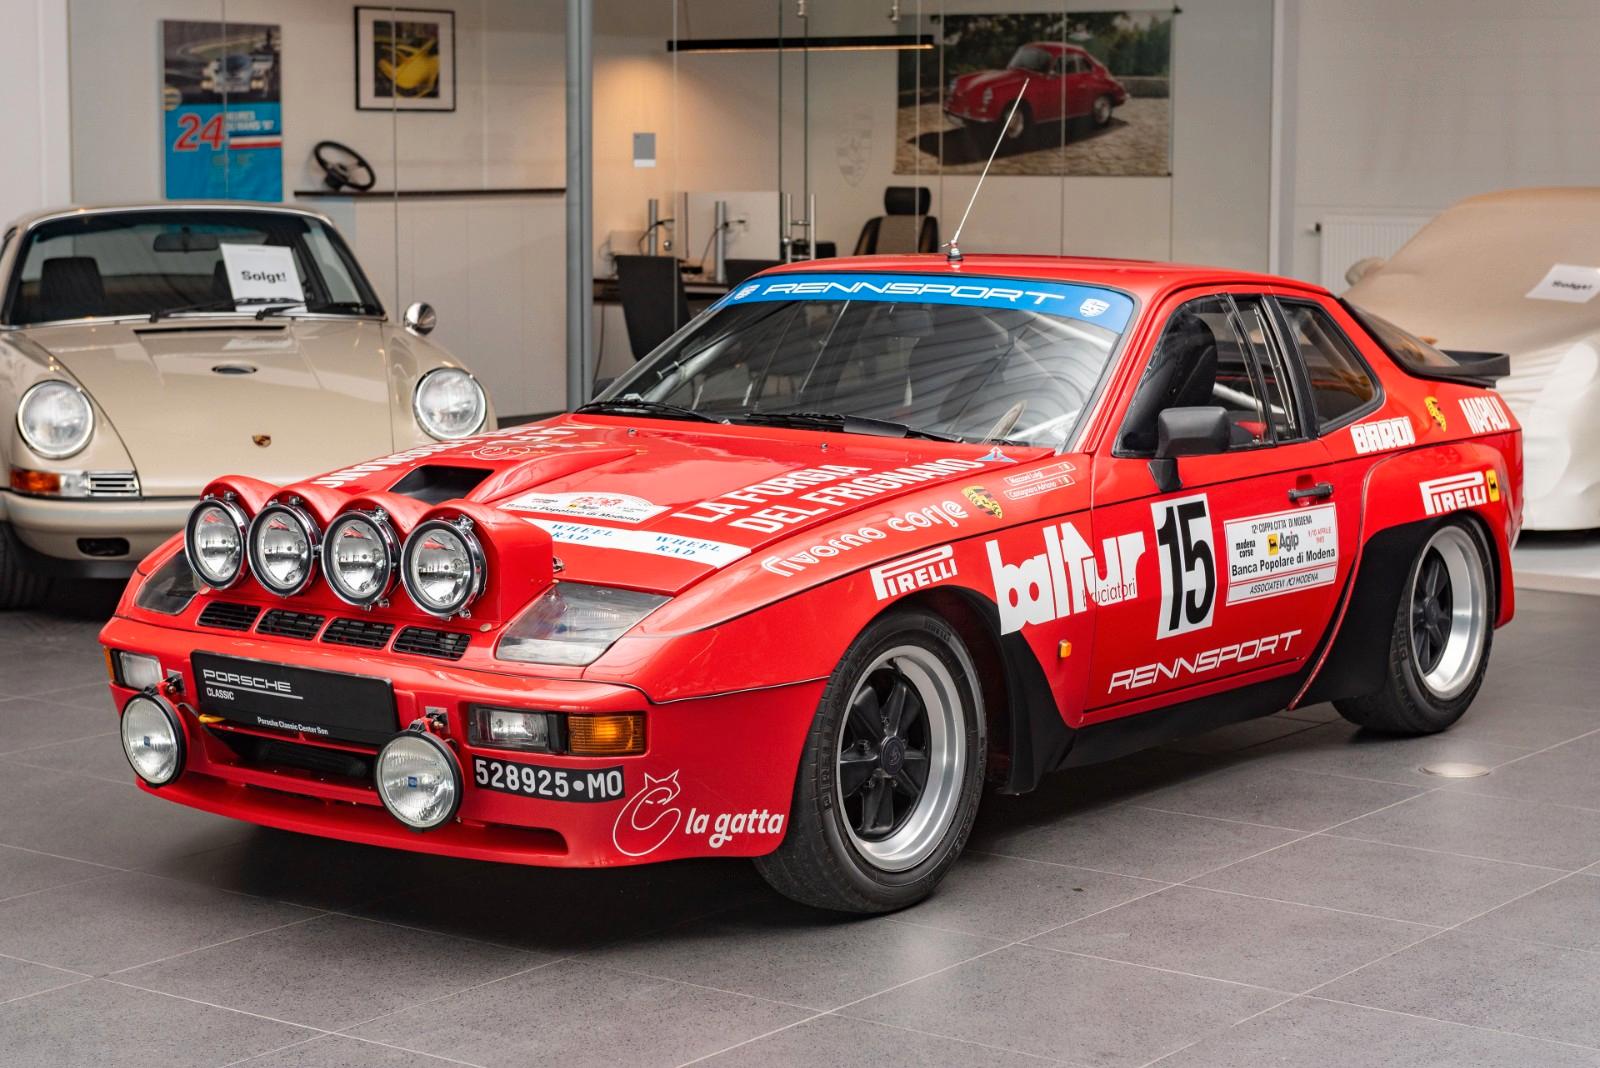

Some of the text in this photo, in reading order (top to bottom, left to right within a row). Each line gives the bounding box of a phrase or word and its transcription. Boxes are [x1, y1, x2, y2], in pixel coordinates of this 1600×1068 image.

[173, 112, 224, 152] 24
[241, 270, 287, 284] Solgt!
[762, 281, 1065, 305] RENNSPORT
[1350, 416, 1416, 454] BARDI
[671, 464, 872, 522] LA FORGIA
[728, 459, 985, 533] DEL FRIGNANO
[1419, 471, 1487, 516] PIRELLI
[552, 524, 614, 537] WHEEL
[1258, 522, 1274, 533] COPPA
[1293, 515, 1312, 528] MODENA
[552, 532, 590, 542] RAD
[655, 535, 720, 552] WHEEL
[1235, 539, 1256, 551] modena
[1279, 531, 1299, 552] Agip
[656, 544, 696, 556] RAD
[1231, 548, 1336, 576] Banca Popolare di Modena
[1239, 549, 1254, 558] corse
[870, 545, 958, 600] PIRELLI
[1156, 501, 1215, 631] 15
[1295, 572, 1319, 584] MODENA
[985, 522, 1146, 635] baltur
[1108, 629, 1302, 694] RENNSPORT
[203, 669, 292, 693] PORSCHE
[206, 687, 235, 701] CLASSIC
[257, 716, 279, 728] Porsche
[278, 719, 299, 731] Classic
[298, 723, 318, 734] Center
[684, 807, 785, 848] la gatta
